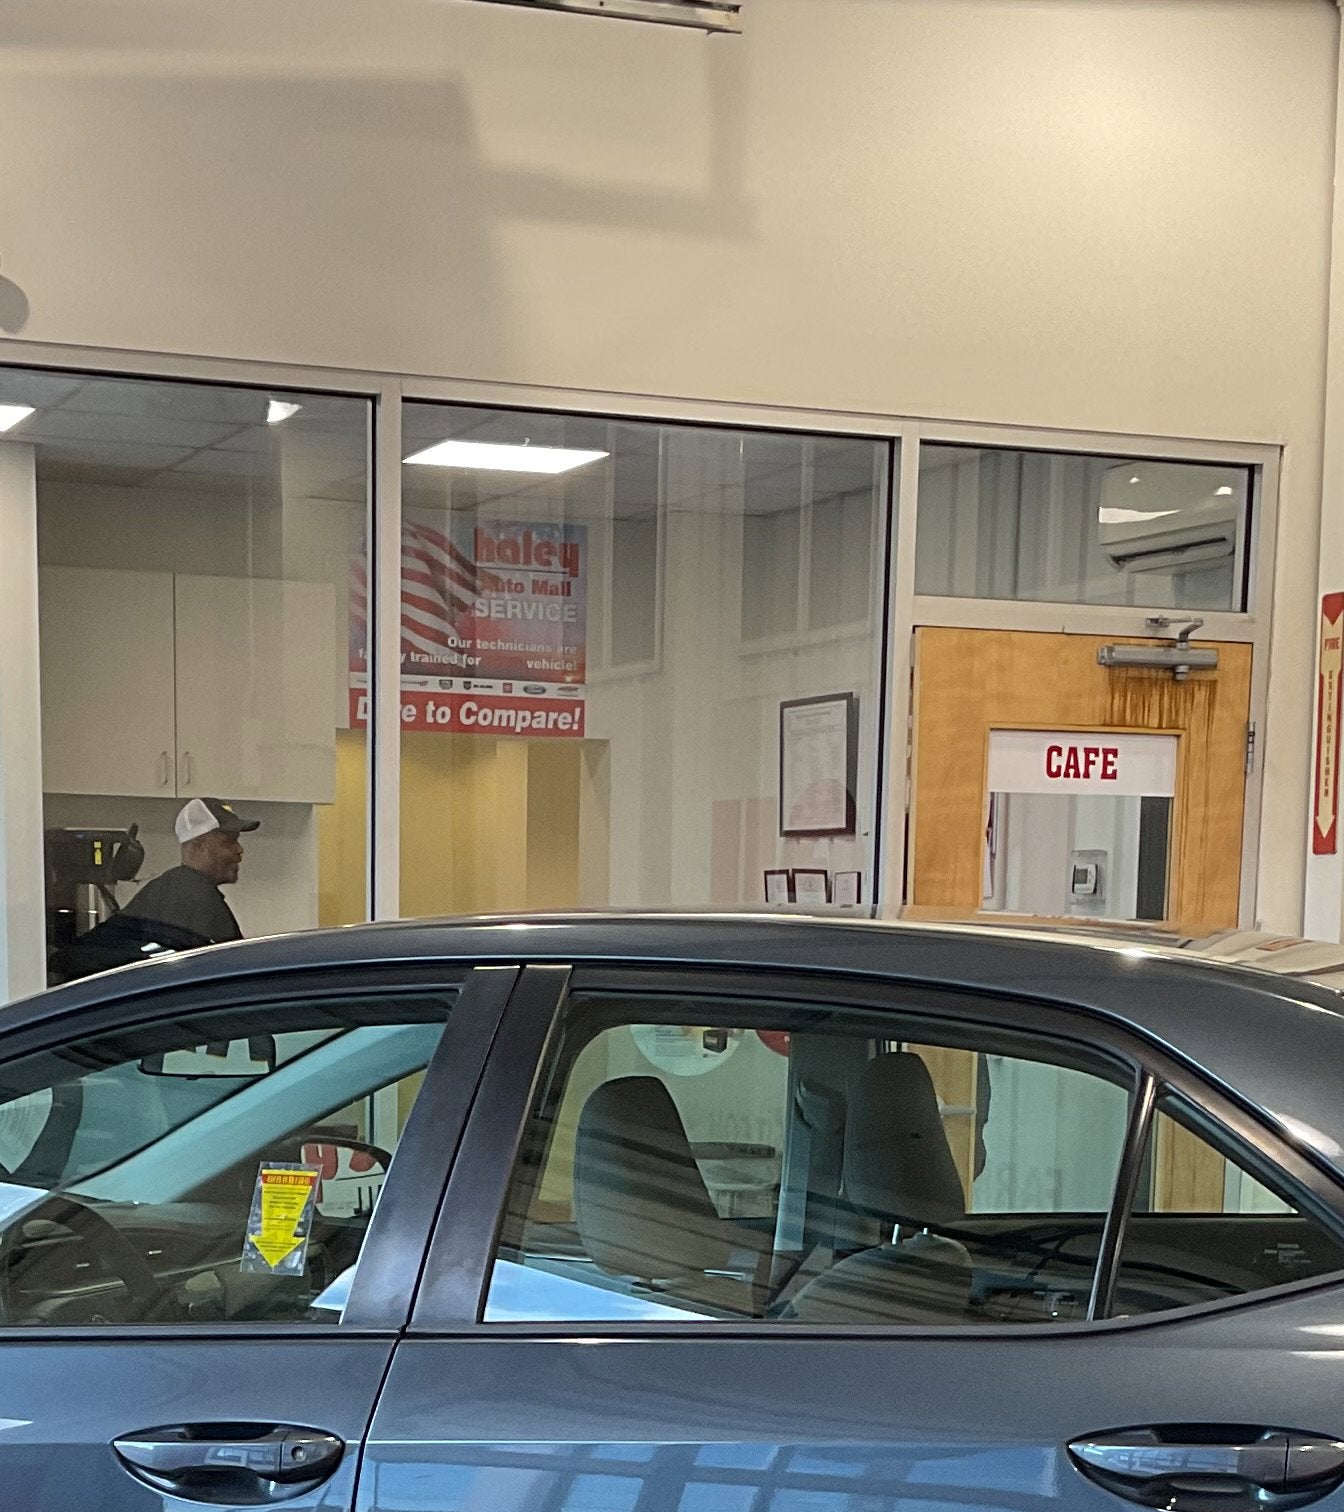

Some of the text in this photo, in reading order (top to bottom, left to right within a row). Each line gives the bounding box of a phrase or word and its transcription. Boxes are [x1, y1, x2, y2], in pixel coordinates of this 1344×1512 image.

[474, 527, 579, 578] haley
[532, 578, 572, 597] Mall
[474, 599, 577, 623] SERVICE
[447, 636, 472, 649] Our
[476, 638, 552, 654] technicians
[410, 650, 458, 665] trained
[460, 653, 482, 667] for
[526, 658, 577, 671] vehicle!
[357, 695, 581, 733] De to Compare!
[1045, 744, 1119, 781] CAFE
